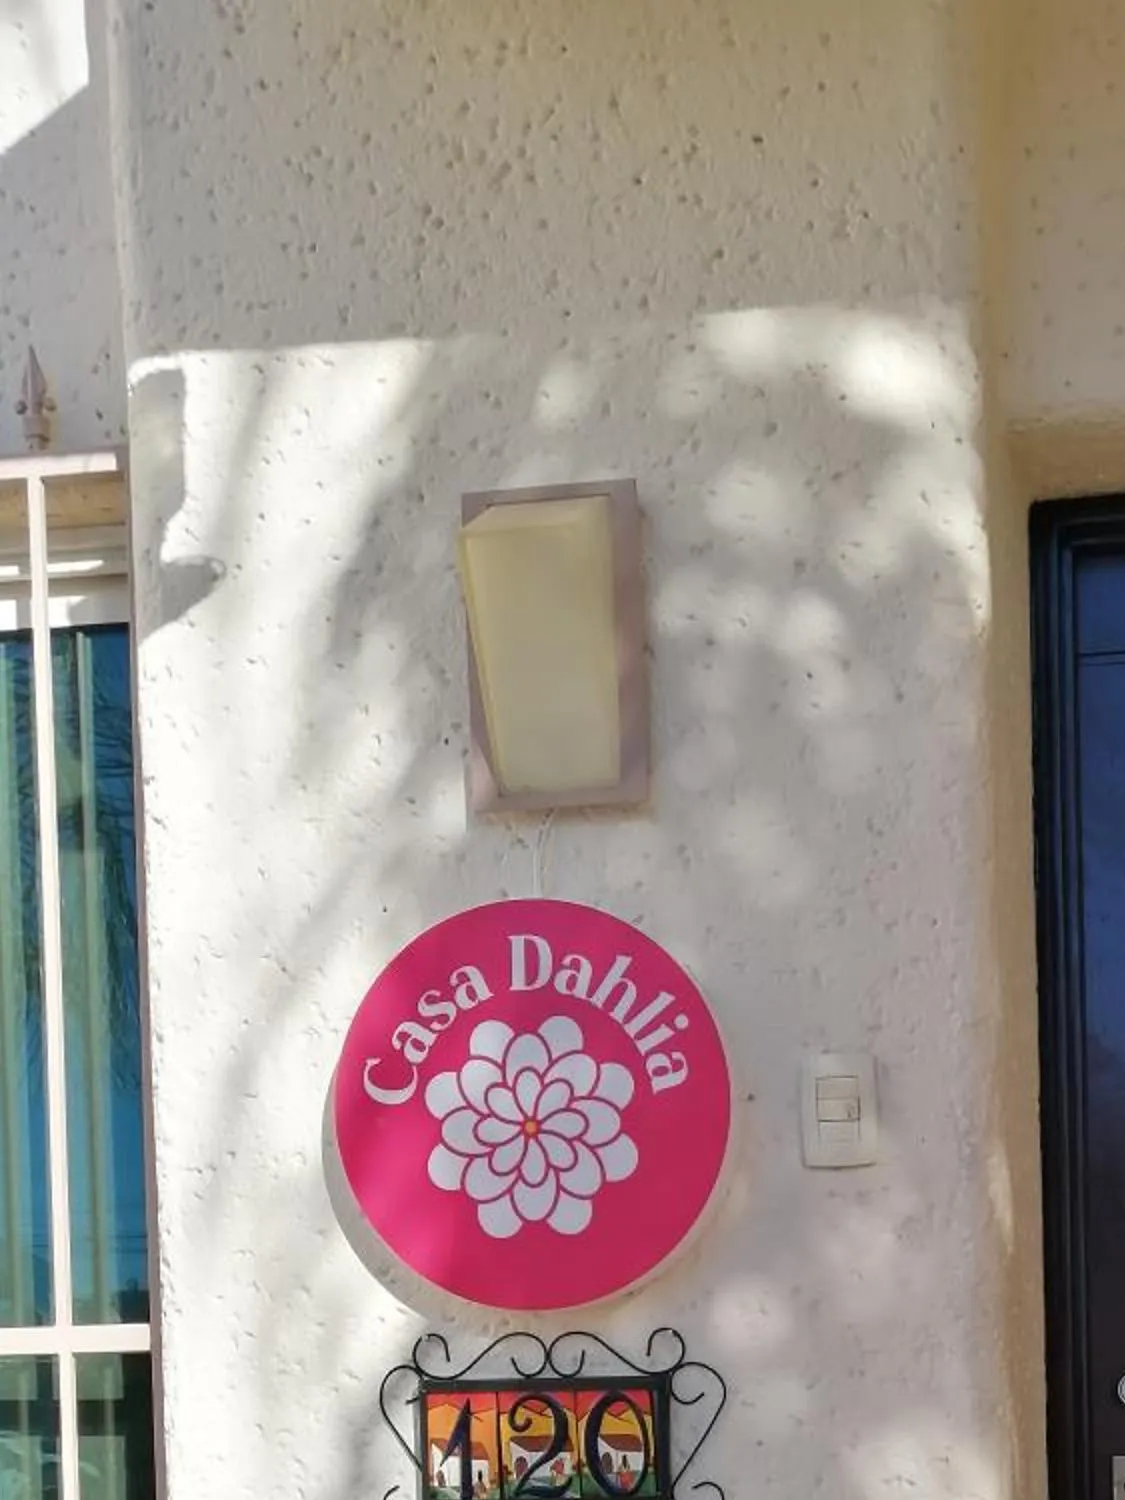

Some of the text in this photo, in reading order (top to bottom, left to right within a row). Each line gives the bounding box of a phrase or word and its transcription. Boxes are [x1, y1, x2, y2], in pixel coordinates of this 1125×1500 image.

[362, 934, 690, 1106] Casa Dahlia
[439, 1390, 649, 1500] 120
